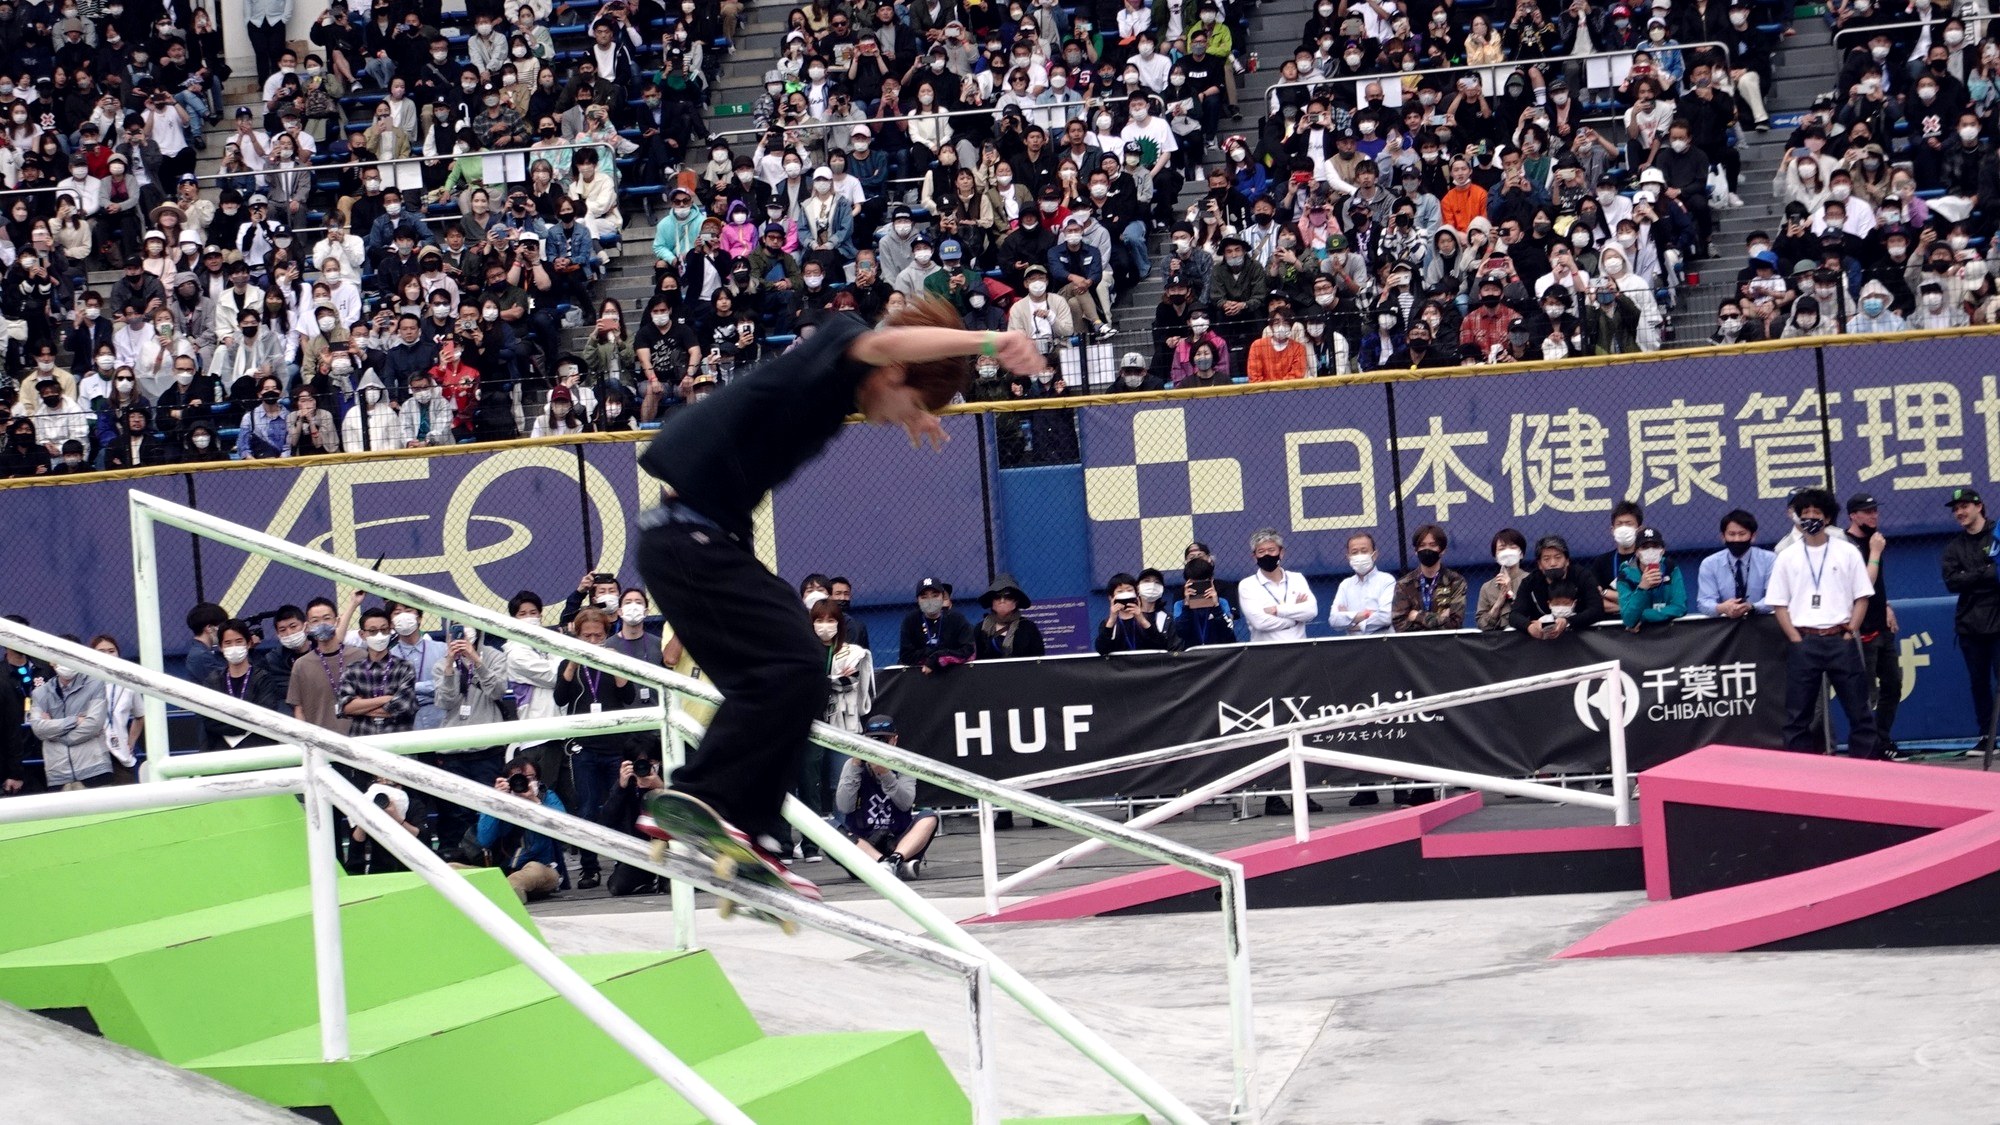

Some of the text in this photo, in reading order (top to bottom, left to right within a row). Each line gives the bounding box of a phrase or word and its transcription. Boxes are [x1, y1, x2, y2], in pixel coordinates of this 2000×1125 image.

[1642, 662, 1757, 704] 千葉市
[954, 704, 1094, 757] HUF
[1312, 727, 1408, 743] エックスモバイル
